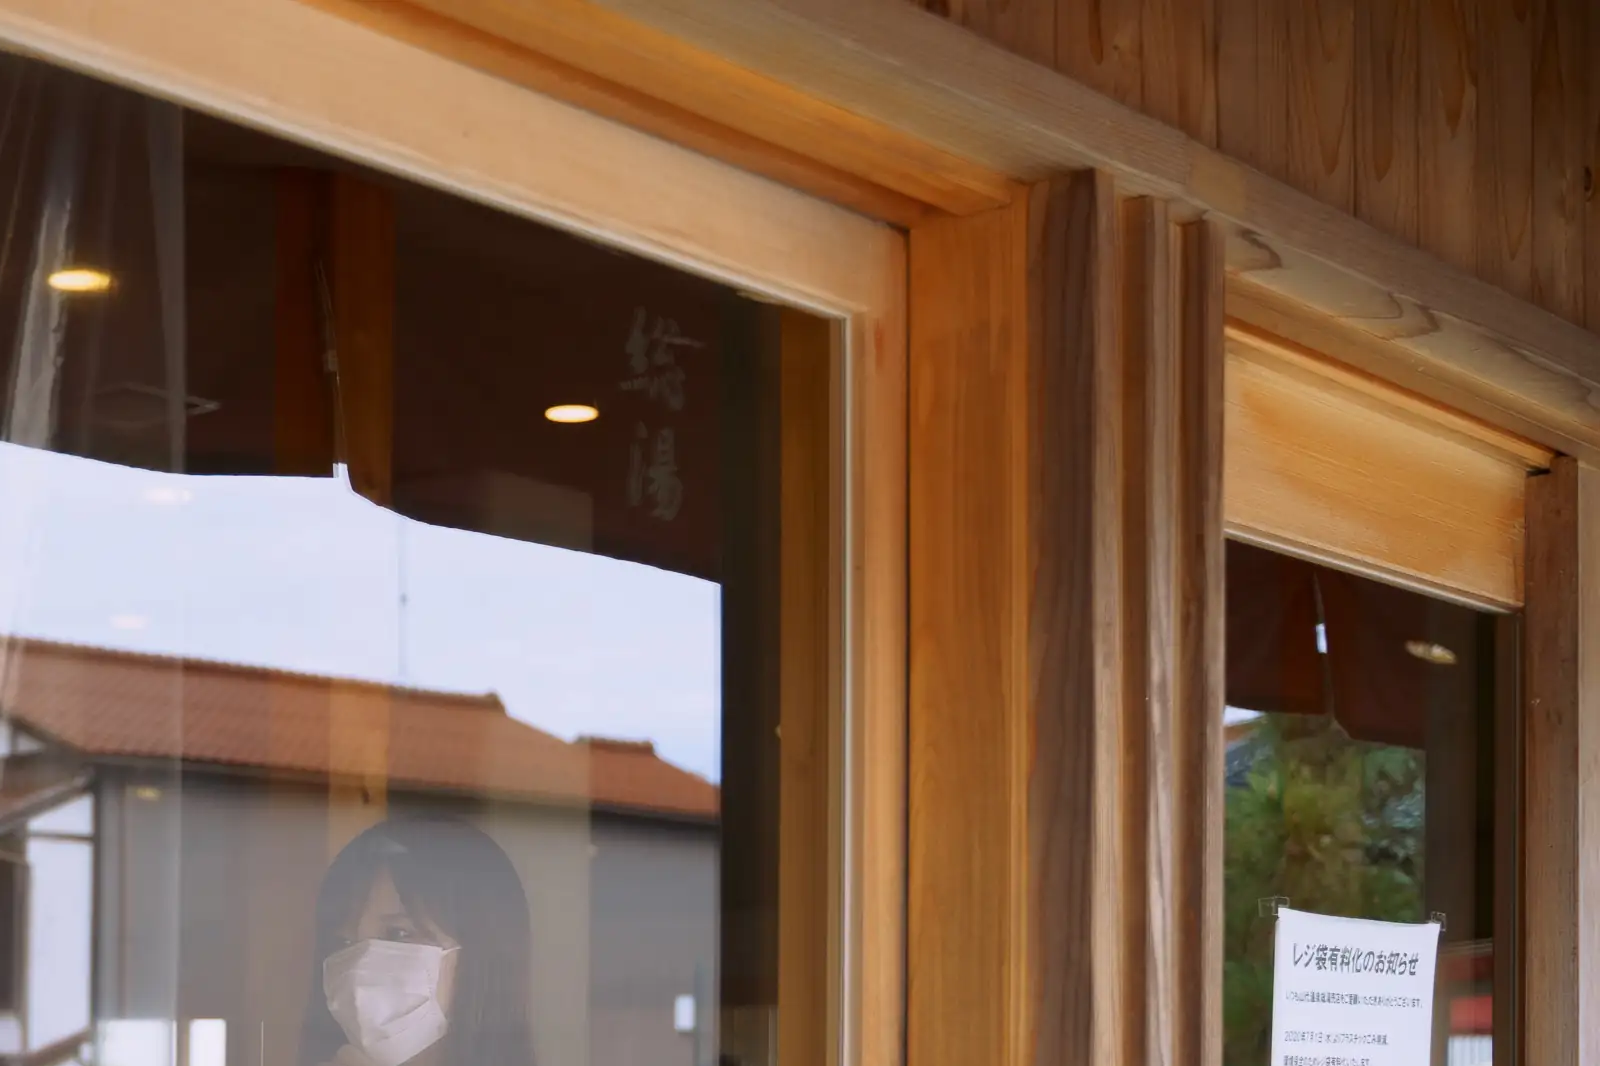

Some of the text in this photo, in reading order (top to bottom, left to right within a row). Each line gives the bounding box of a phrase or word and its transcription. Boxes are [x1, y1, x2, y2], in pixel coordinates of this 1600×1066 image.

[1292, 943, 1420, 976] レジ袋有料化のお知らせ
